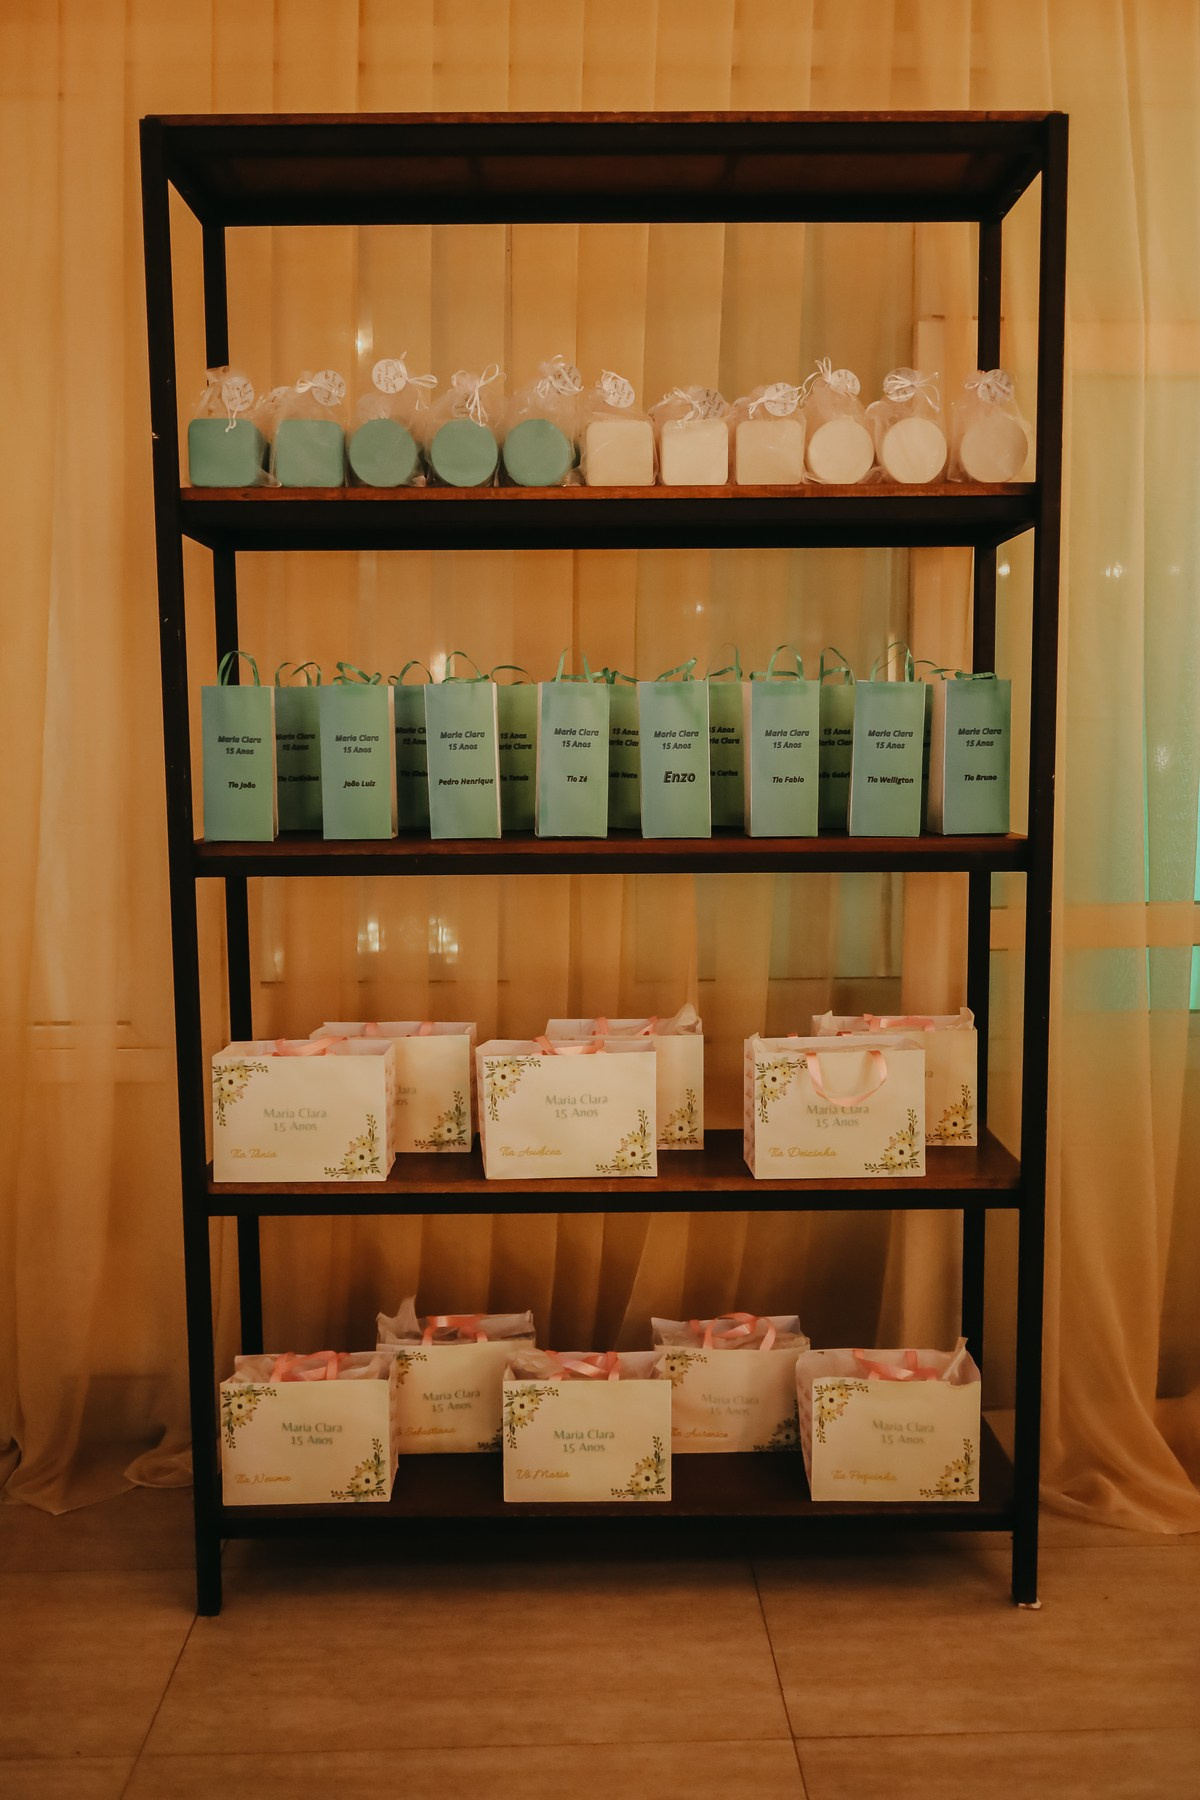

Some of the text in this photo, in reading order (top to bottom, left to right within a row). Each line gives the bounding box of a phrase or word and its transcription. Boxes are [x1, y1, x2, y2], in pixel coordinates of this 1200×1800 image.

[554, 728, 599, 736] Maria Clara
[654, 730, 676, 738] Maria
[218, 735, 262, 744] Maria Clara
[438, 778, 494, 786] Pedro Henrique
[664, 771, 696, 783] Enzo
[880, 776, 914, 785] Welligton
[239, 781, 256, 790] João
[343, 780, 360, 789] João
[545, 1094, 608, 1105] Maria Clara
[263, 1108, 327, 1119] Maria Clara
[555, 1108, 599, 1119] 15 Anos
[806, 1104, 870, 1115] Maria Clara
[273, 1121, 318, 1132] 15 Anos
[816, 1118, 860, 1128] 15 Anos
[230, 1149, 248, 1158] Tia
[500, 1146, 516, 1157] Tia
[768, 1147, 785, 1158] Tia
[422, 1389, 481, 1401] Maria Clara
[702, 1394, 760, 1405] Maria Clara
[431, 1401, 473, 1413] 15 Anos
[710, 1407, 750, 1416] 15 Anos
[282, 1422, 343, 1433] Maria Clara
[872, 1420, 935, 1433] Maria Clara
[554, 1429, 615, 1440] Maria Clara
[881, 1435, 925, 1445] 15 Anos
[290, 1435, 333, 1446] 15 Anos
[563, 1443, 606, 1453] 15 Anos
